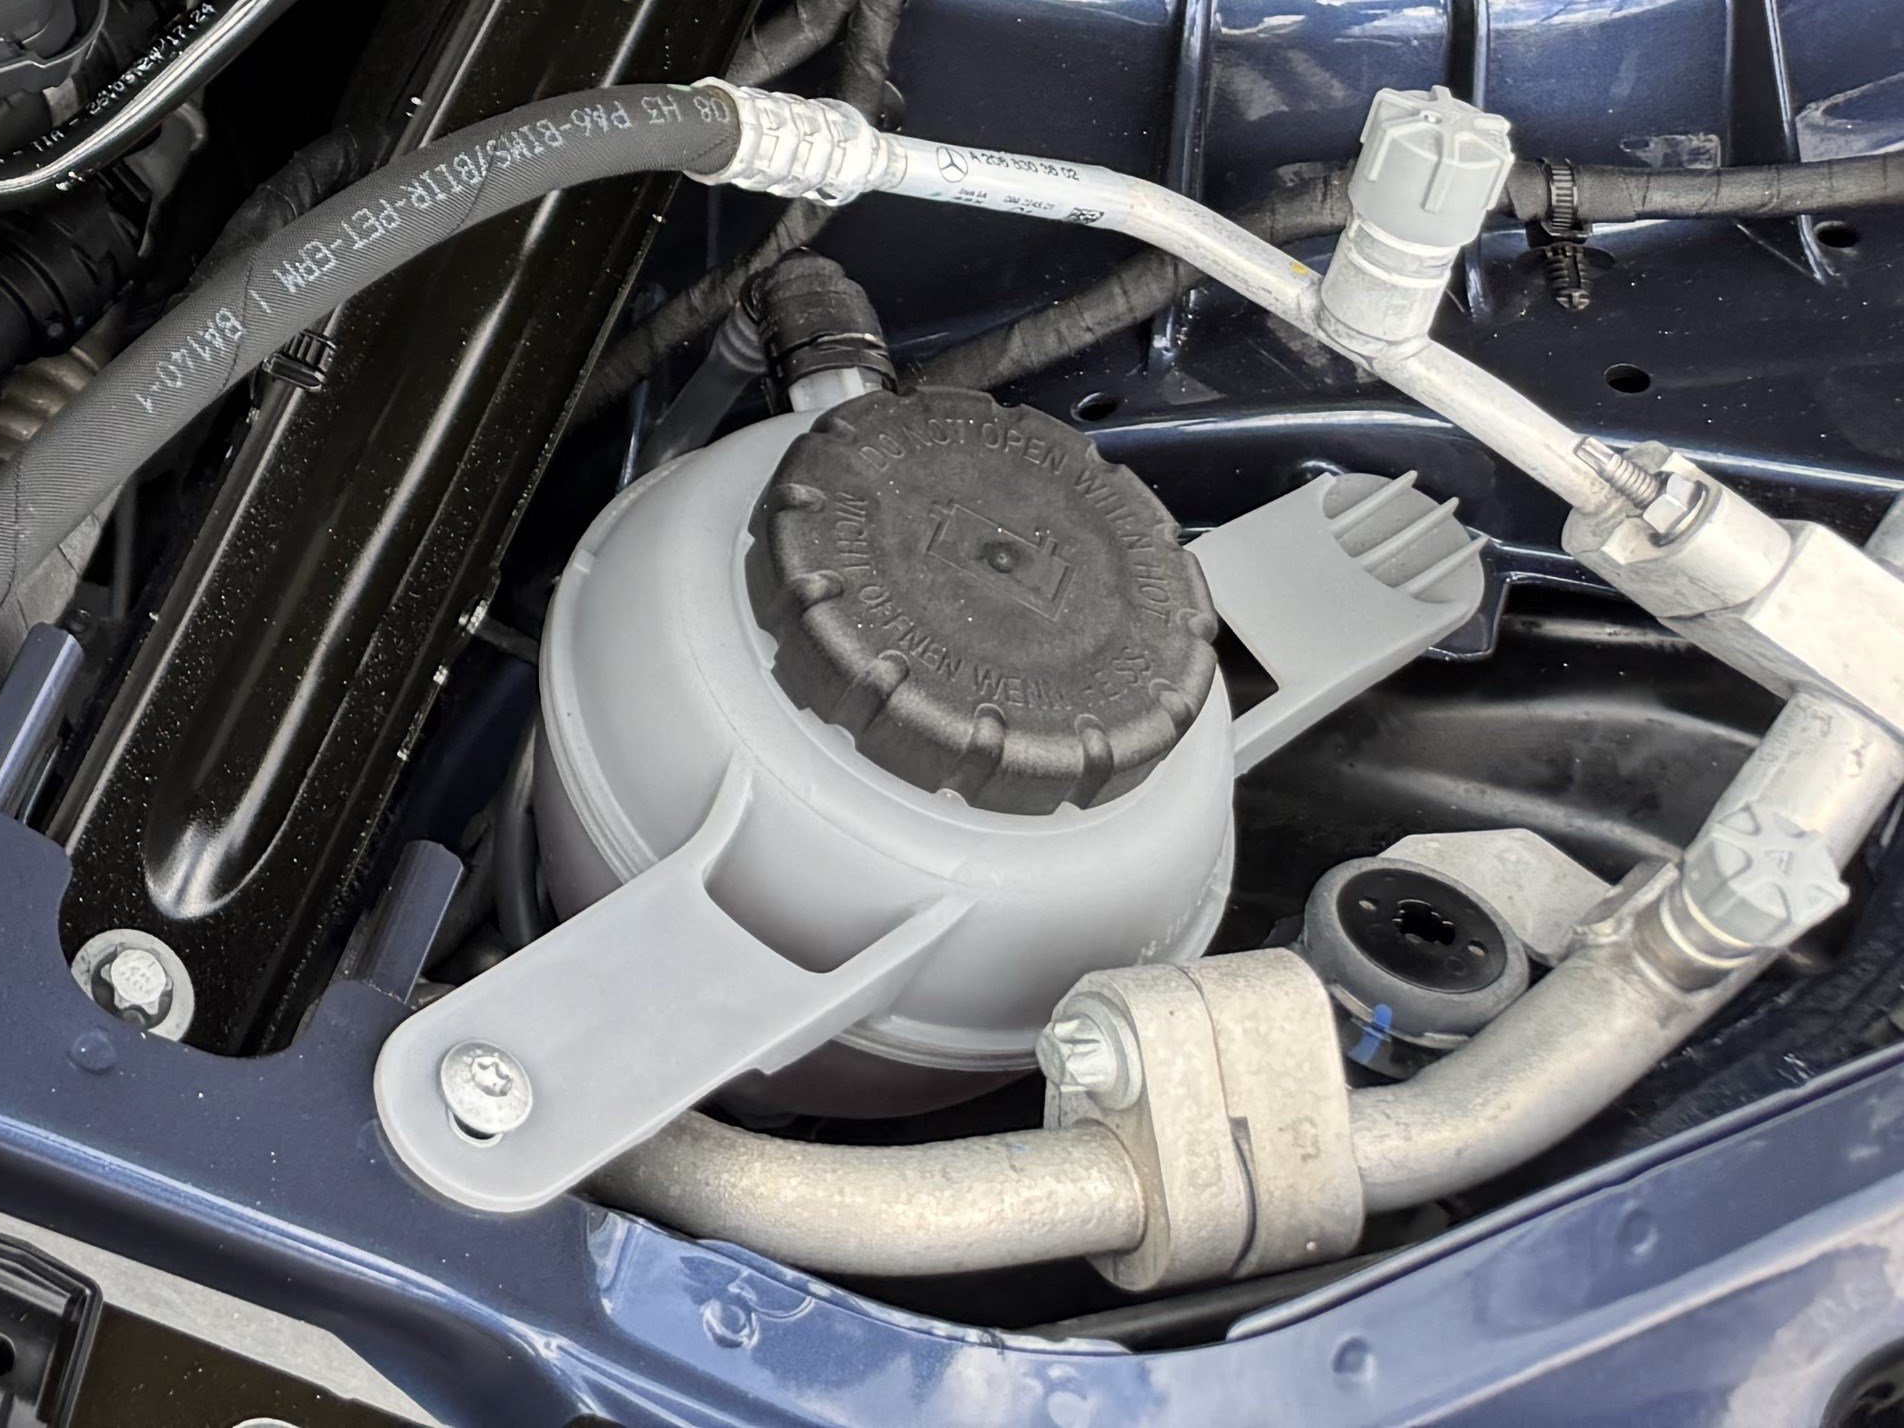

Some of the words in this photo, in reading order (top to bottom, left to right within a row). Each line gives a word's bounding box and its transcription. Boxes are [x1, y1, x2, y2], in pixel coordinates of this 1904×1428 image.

[859, 433, 906, 472] DO
[901, 418, 966, 448] NOT
[980, 421, 1070, 476] OPEN
[1074, 468, 1155, 553] WHEN
[1132, 561, 1171, 623] HOT
